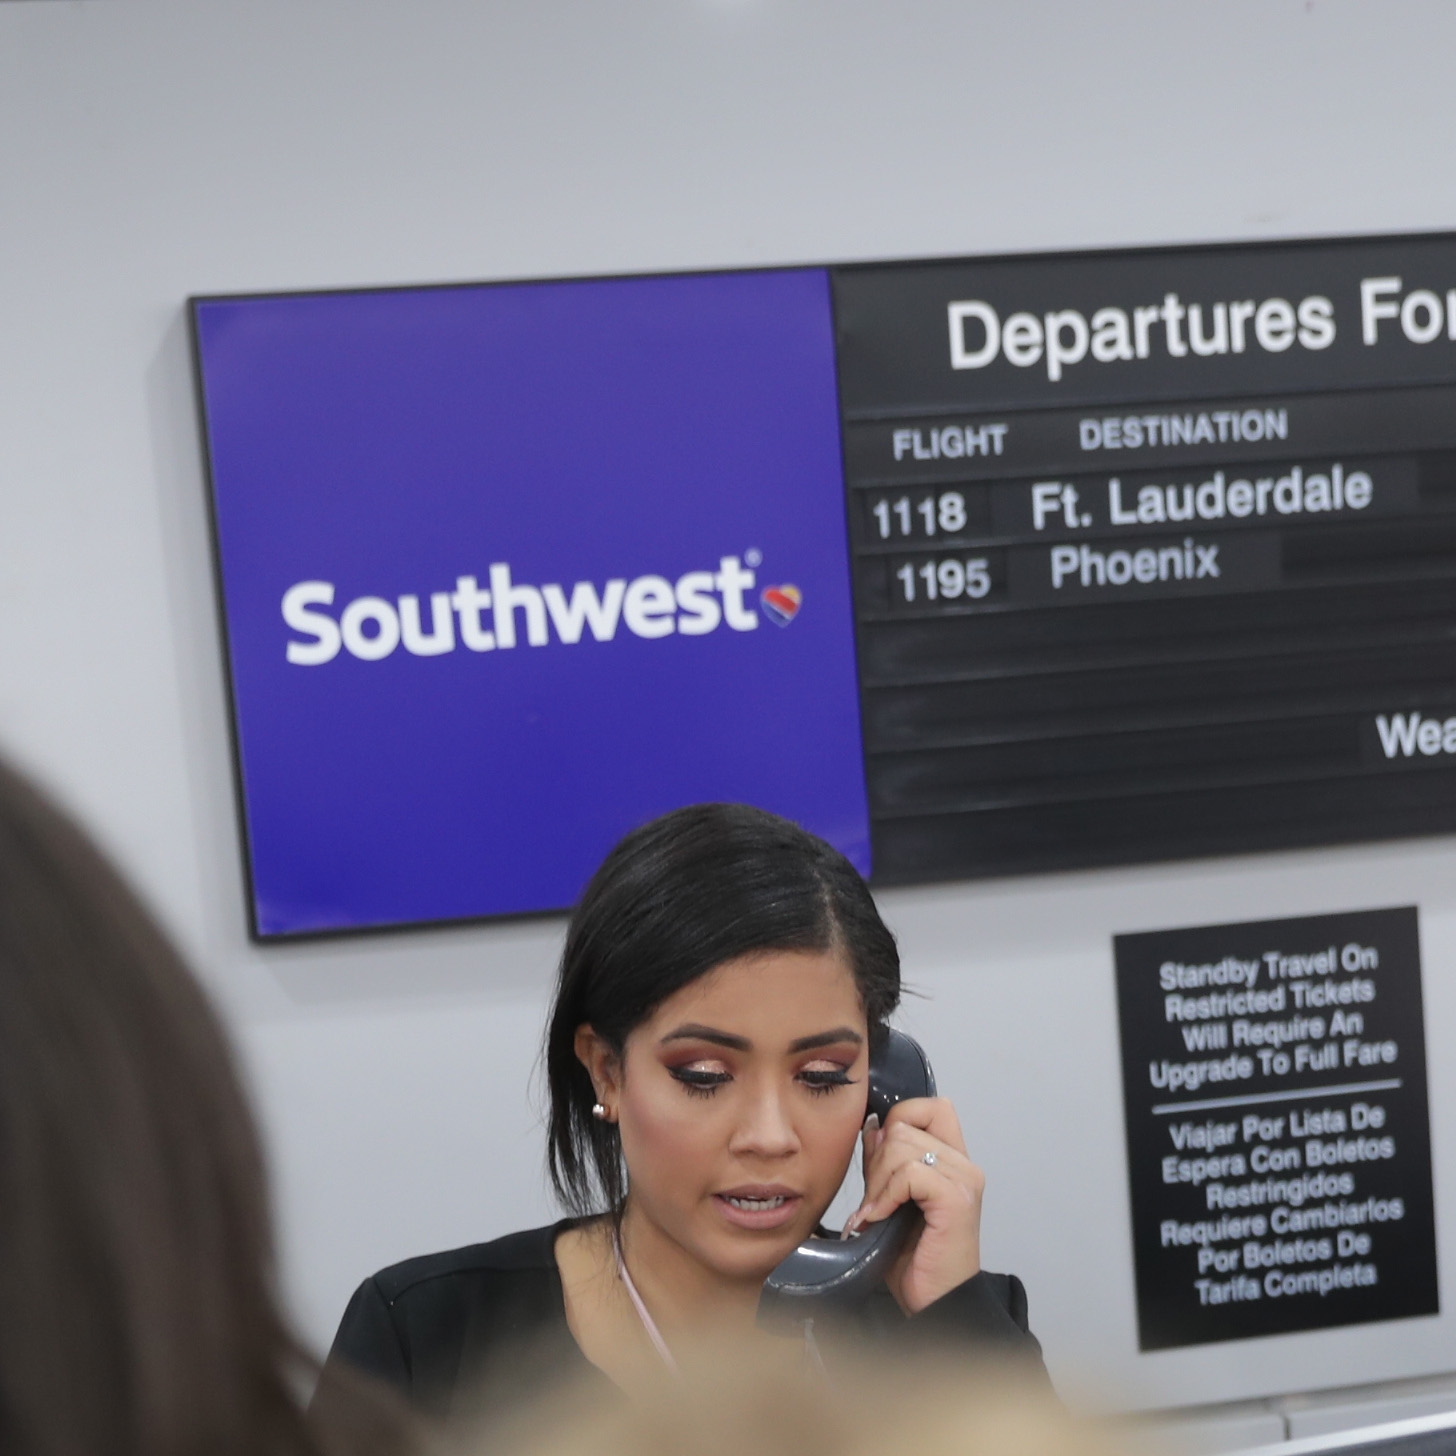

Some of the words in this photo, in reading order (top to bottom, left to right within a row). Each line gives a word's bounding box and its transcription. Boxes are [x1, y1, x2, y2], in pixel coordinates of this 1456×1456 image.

[947, 293, 1335, 381] Departures
[893, 424, 1008, 461] FLIGHT
[1079, 409, 1288, 450] DESTINATION
[873, 491, 967, 538] 1118
[1031, 482, 1093, 530] Ft.
[1109, 464, 1374, 525] Lauderdale
[897, 558, 991, 602] 1195
[1050, 537, 1221, 589] Phoenix
[1160, 959, 1260, 989] Standby
[1264, 948, 1337, 979] Travel
[1341, 945, 1378, 972] On
[1165, 985, 1286, 1021] Restricted
[1290, 979, 1375, 1008] Tickets
[1182, 1023, 1228, 1051] Will
[1232, 1016, 1326, 1047] Require
[1330, 1010, 1363, 1036] An
[1150, 1055, 1253, 1091] Upgrade
[1258, 1051, 1290, 1075] To
[1295, 1044, 1339, 1072] Full
[1344, 1040, 1398, 1067] Fare
[1169, 1121, 1238, 1152] Viajar
[1243, 1116, 1284, 1142] Por
[1290, 1110, 1346, 1132] Lista
[1351, 1103, 1386, 1130] De
[1162, 1155, 1246, 1185] Espera
[1250, 1145, 1301, 1173] Con
[1306, 1137, 1394, 1167] Boletos
[1206, 1172, 1355, 1206] Restringidos
[1160, 1214, 1267, 1247] Requiere
[1271, 1197, 1404, 1234] Cambiarlos
[1197, 1248, 1241, 1274] Por
[1244, 1239, 1332, 1269] Boletos
[1337, 1230, 1371, 1257] De
[1195, 1276, 1261, 1306] Tarifa
[1264, 1262, 1377, 1299] Completa
